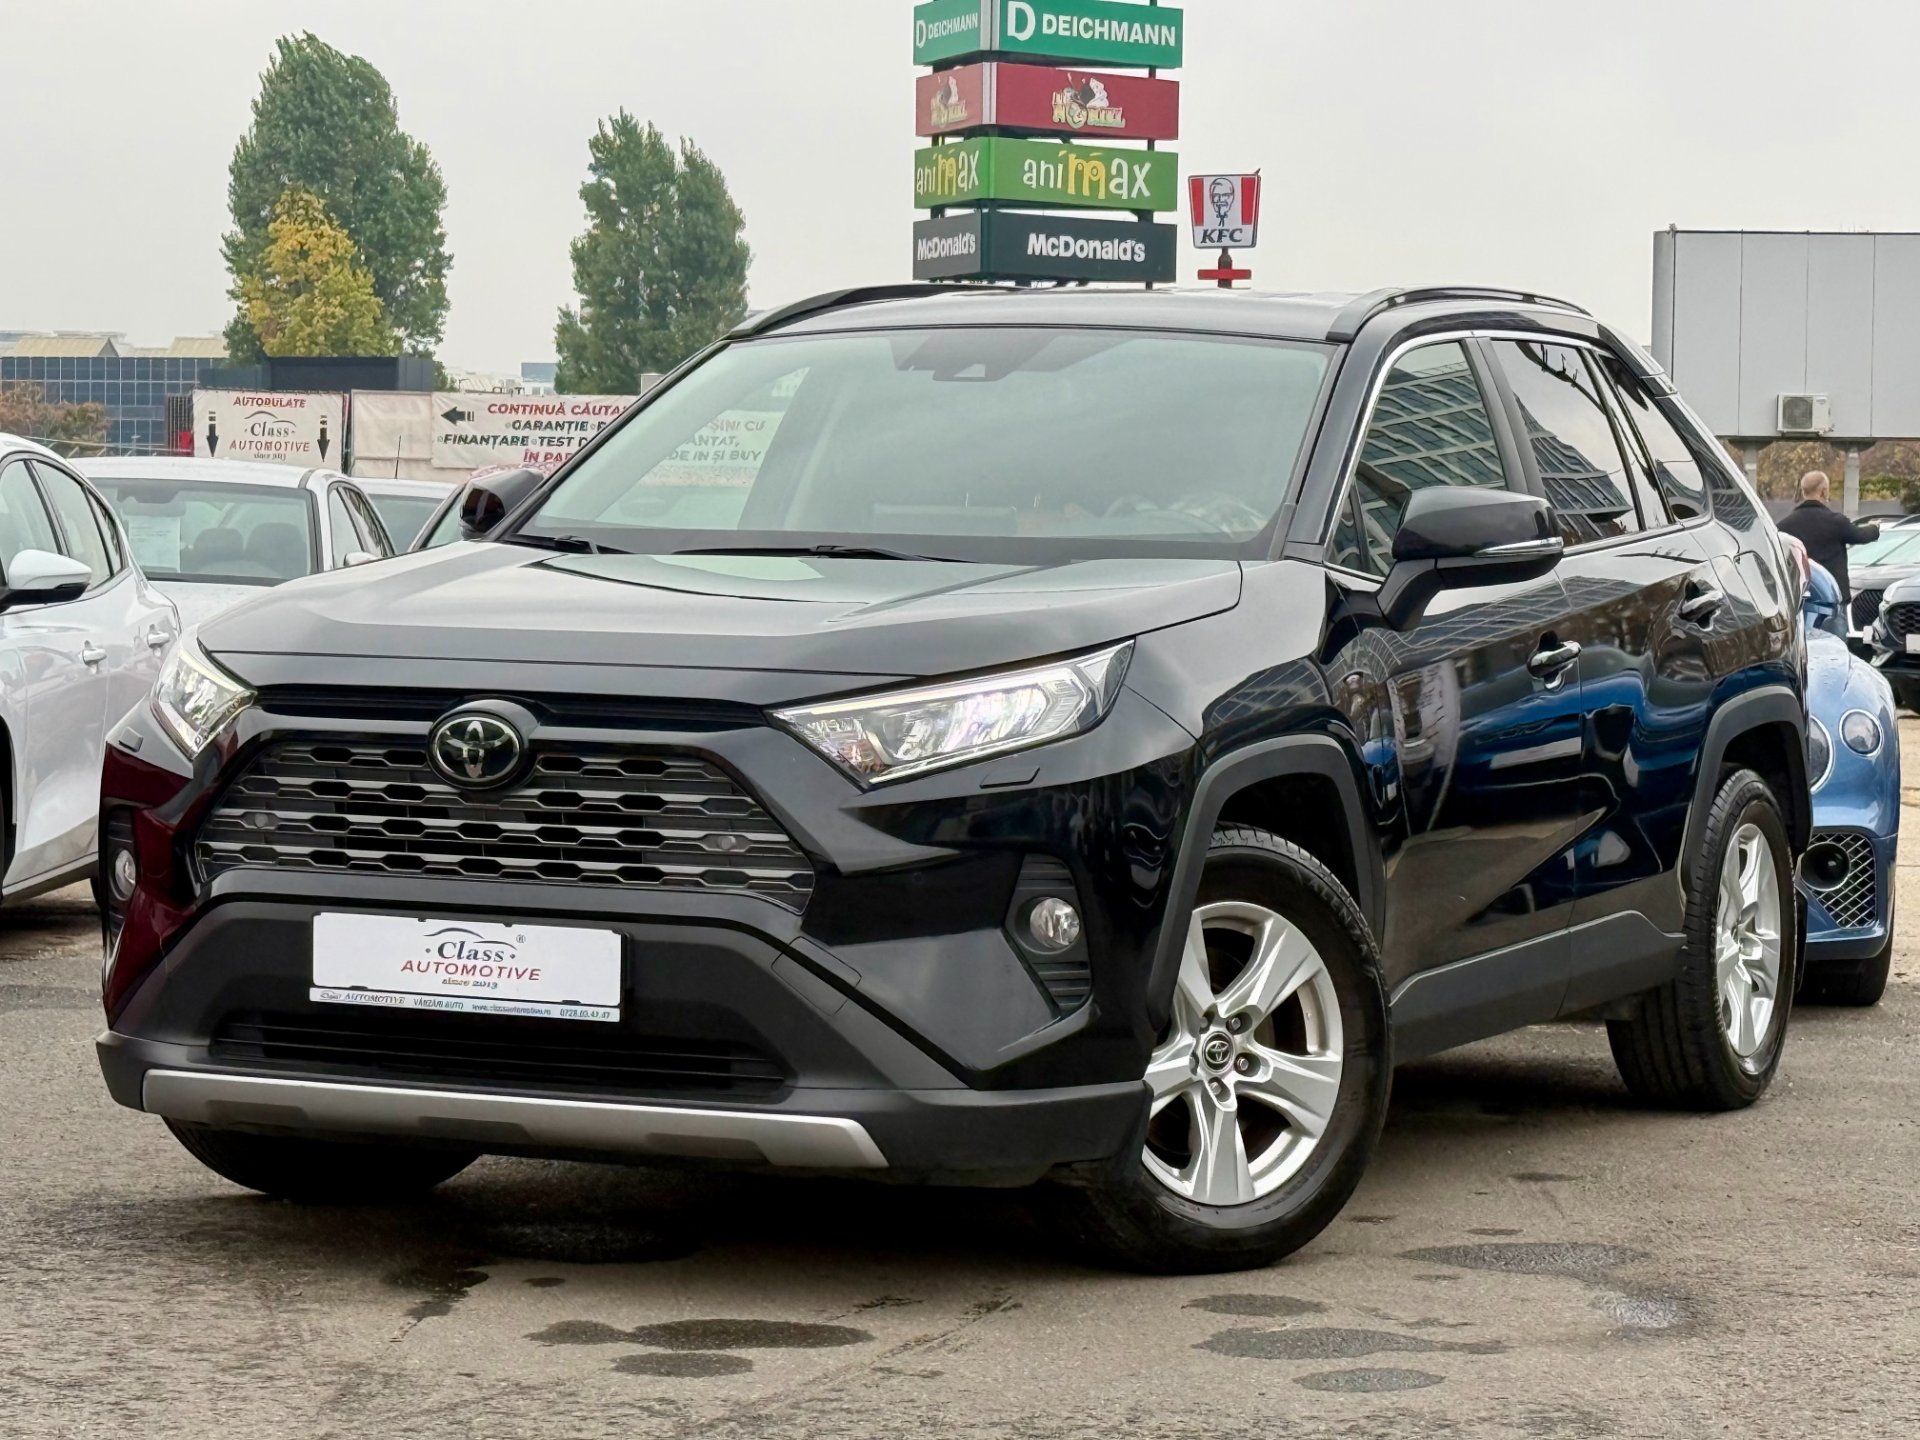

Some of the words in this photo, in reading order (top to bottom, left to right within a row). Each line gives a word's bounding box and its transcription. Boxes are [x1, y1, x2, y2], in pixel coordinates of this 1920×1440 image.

[916, 20, 926, 48] D
[928, 12, 978, 39] DEICHMANN
[1007, 1, 1036, 41] D
[1042, 13, 1176, 47] DEICHMANN
[916, 149, 980, 197] animax
[1023, 150, 1152, 199] animax
[917, 232, 976, 261] McDonald's
[1027, 233, 1146, 262] McDonald's
[1200, 228, 1244, 244] KFC
[487, 402, 566, 415] CONTINUĂ
[571, 402, 627, 416] CĂUTA
[250, 421, 290, 437] Class
[229, 439, 310, 452] AUTOMOTIVE
[538, 436, 575, 447] TEST
[729, 450, 761, 461] BUY
[437, 940, 505, 962] Class
[401, 960, 541, 981] AUTOMOTIVE
